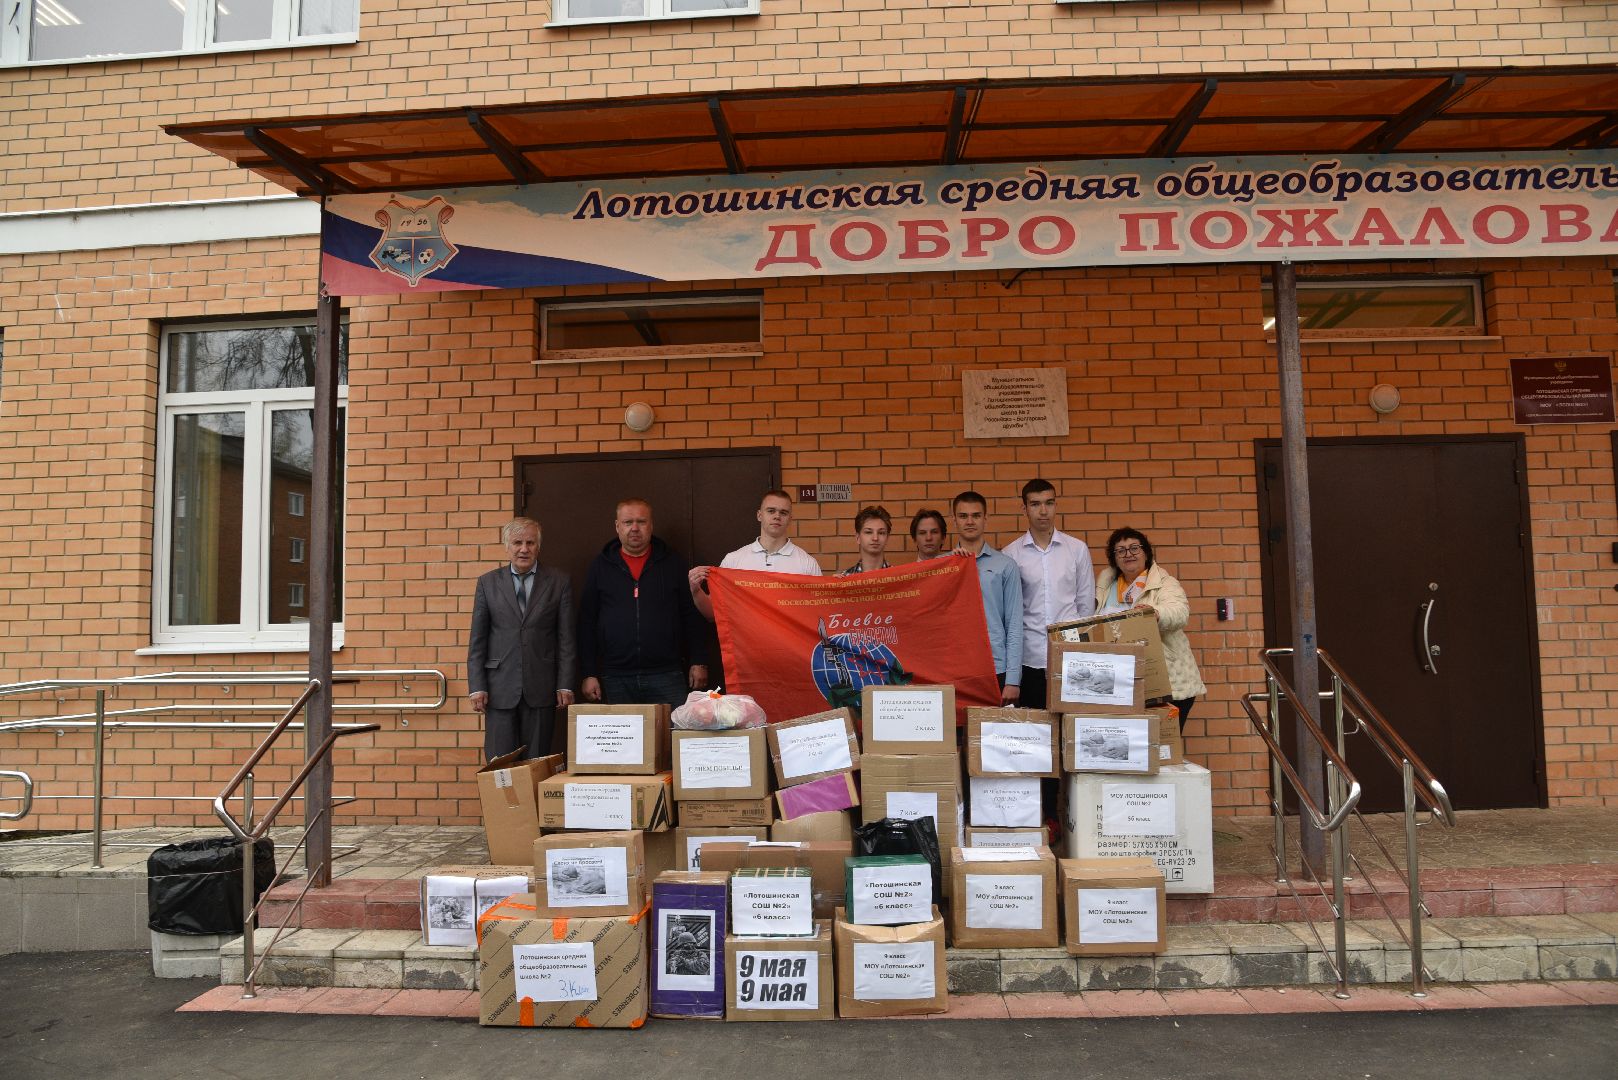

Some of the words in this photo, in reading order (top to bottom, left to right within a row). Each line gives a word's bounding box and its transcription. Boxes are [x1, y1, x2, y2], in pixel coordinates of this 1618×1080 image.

[572, 181, 924, 220] Лотошинская
[940, 169, 1140, 211] средняя
[755, 215, 1076, 271] ДОБРО
[802, 489, 815, 497] 131
[828, 612, 893, 629] Боевое
[739, 955, 755, 978] 9
[759, 958, 807, 978] мая
[740, 979, 756, 1003] 9
[759, 982, 808, 1002] мая
